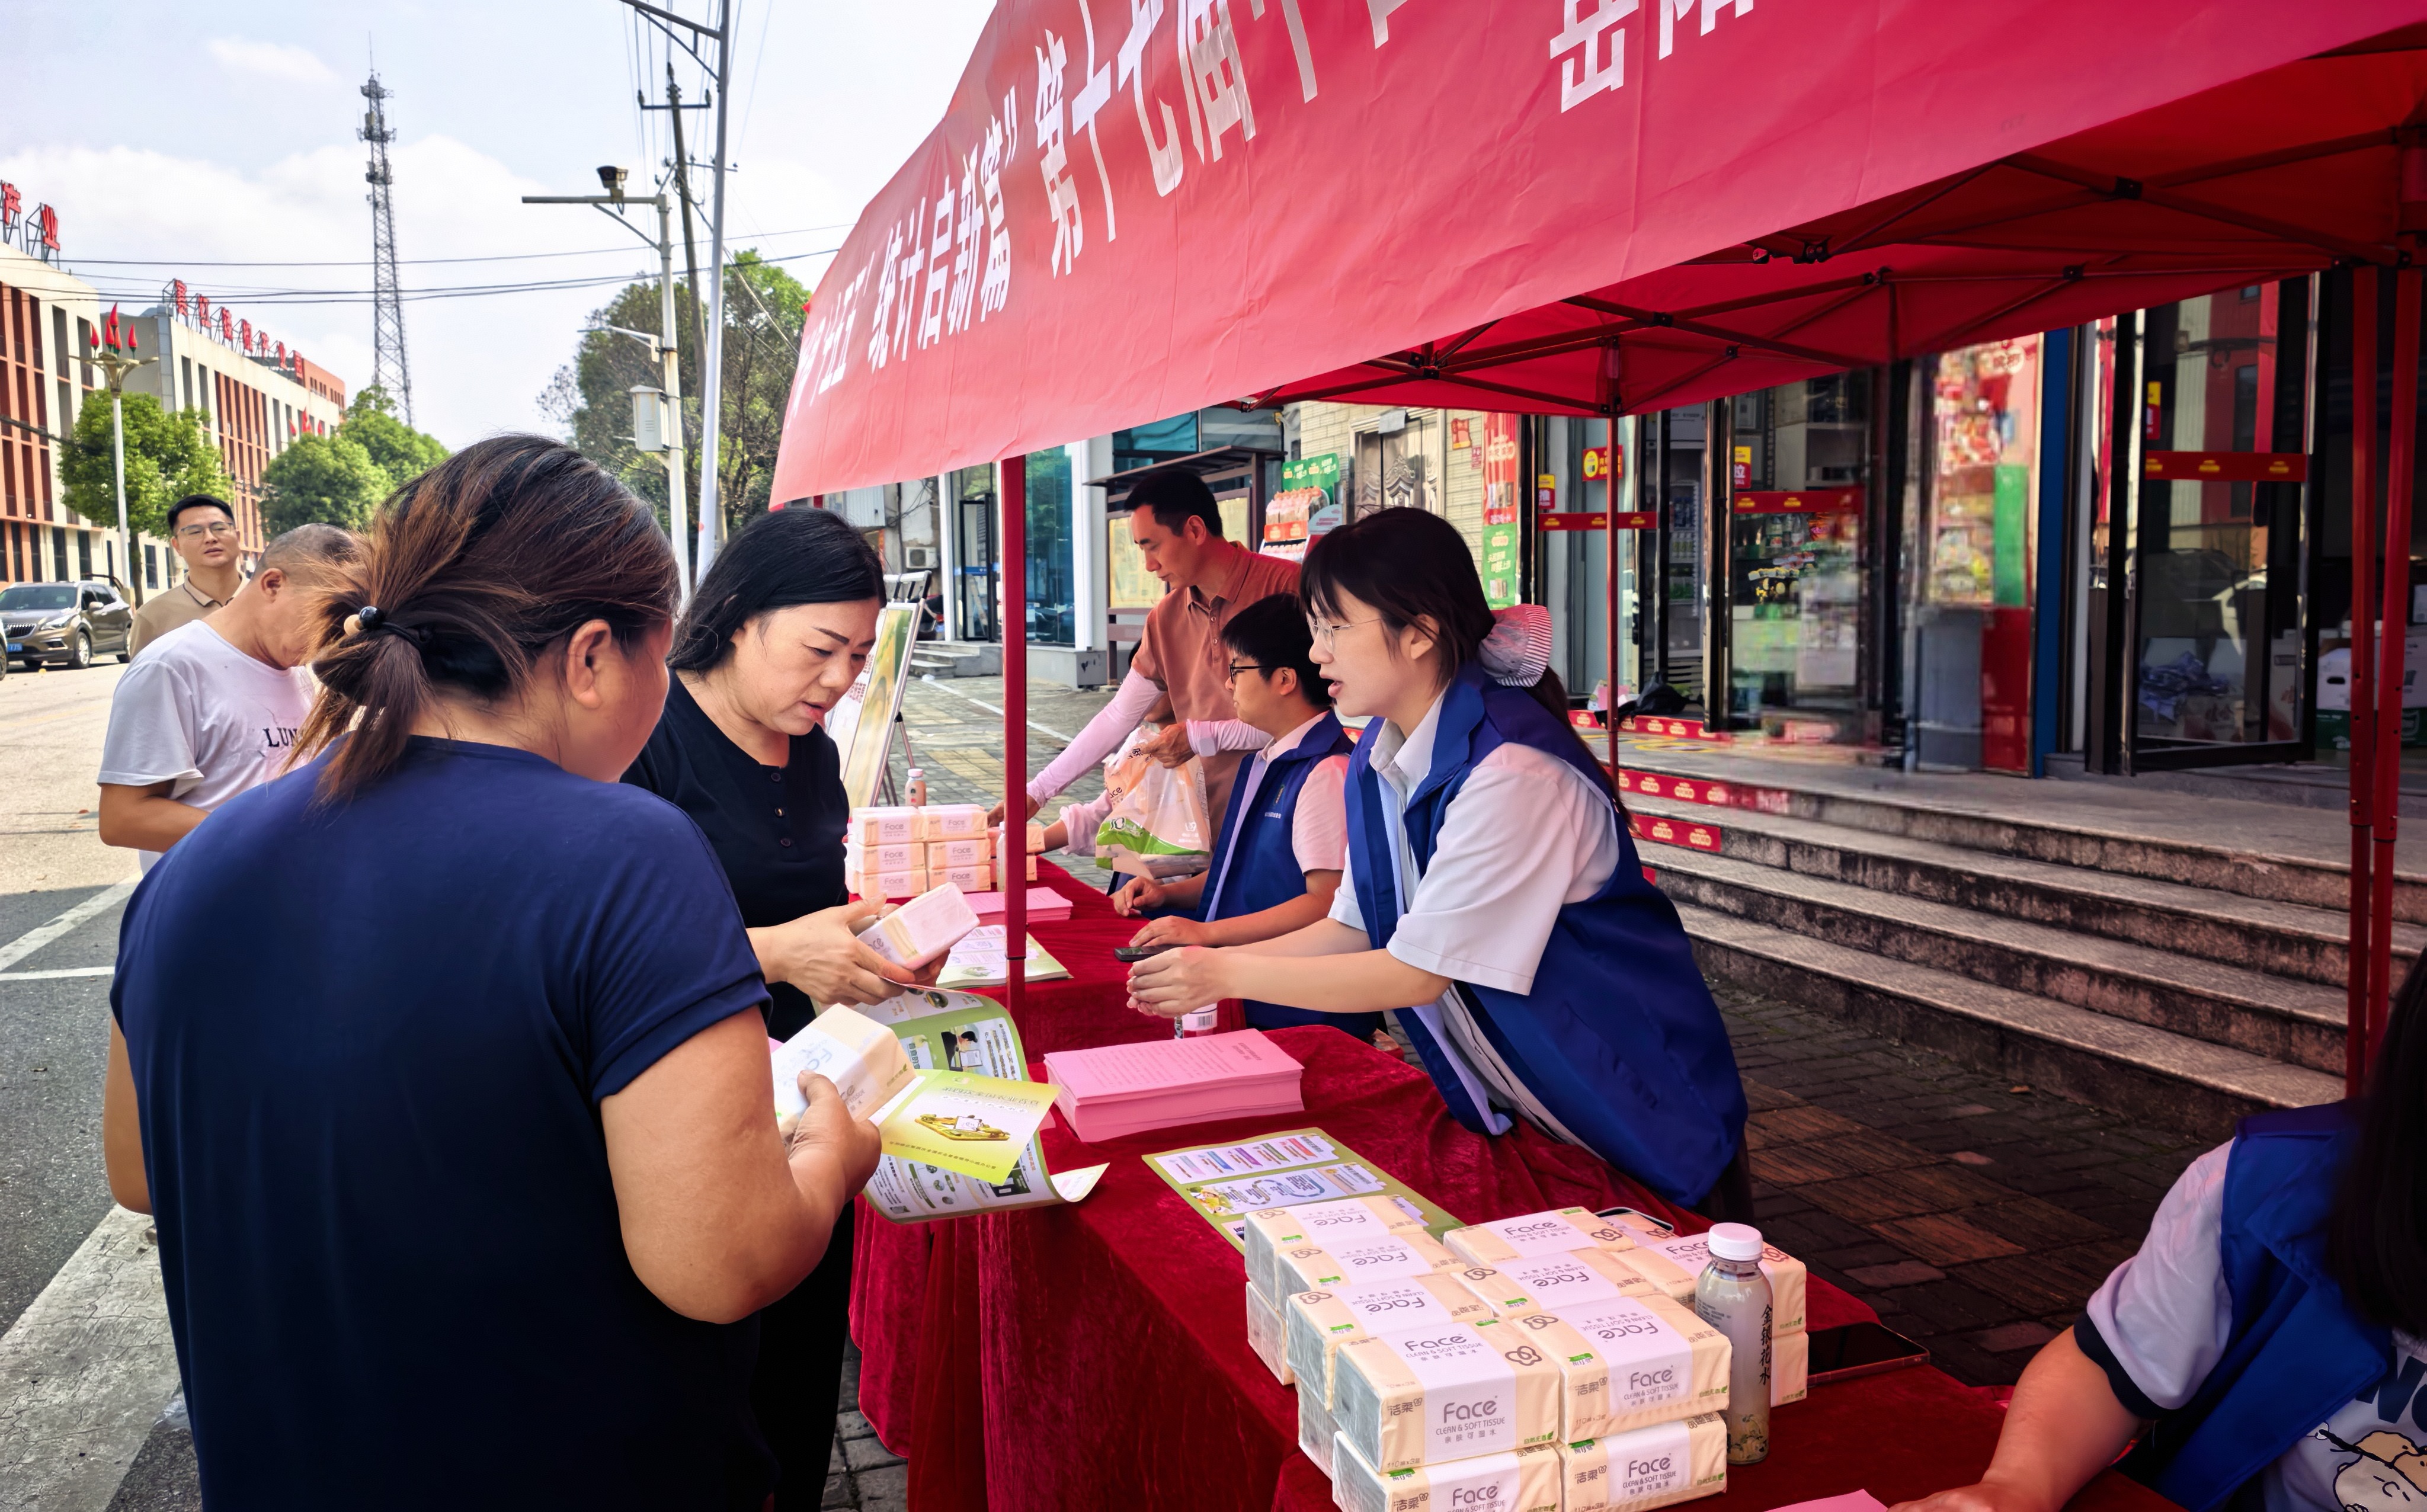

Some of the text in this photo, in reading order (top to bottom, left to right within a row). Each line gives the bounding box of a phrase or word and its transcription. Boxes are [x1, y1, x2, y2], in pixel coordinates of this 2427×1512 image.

[1314, 1215, 1366, 1226] Face
[1504, 1222, 1557, 1235] Face
[1352, 1252, 1408, 1265] Face
[1533, 1271, 1589, 1287] Face
[1365, 1298, 1425, 1312] Face
[1598, 1322, 1658, 1339] Face
[1405, 1336, 1467, 1351] Face
[1759, 1304, 1772, 1386] 金银花水
[1631, 1369, 1673, 1390] Face
[1575, 1381, 1599, 1396] 洁柔
[1647, 1386, 1660, 1395] SOFT
[1661, 1383, 1679, 1391] TISSUE
[1388, 1402, 1414, 1416] 洁柔
[1444, 1400, 1497, 1423] Face
[1436, 1425, 1456, 1436] CLEAN
[1465, 1421, 1481, 1430] SOFT
[1483, 1417, 1504, 1427] TISSUE
[1629, 1457, 1670, 1478] Face
[1575, 1469, 1597, 1484] 洁柔
[1623, 1479, 1638, 1488] CLEAN
[1645, 1475, 1658, 1483] SOFT
[1660, 1471, 1676, 1480] TISSUE
[1453, 1485, 1498, 1506] Face
[1394, 1497, 1419, 1511] 洁柔
[1487, 1500, 1504, 1508] TISSUE
